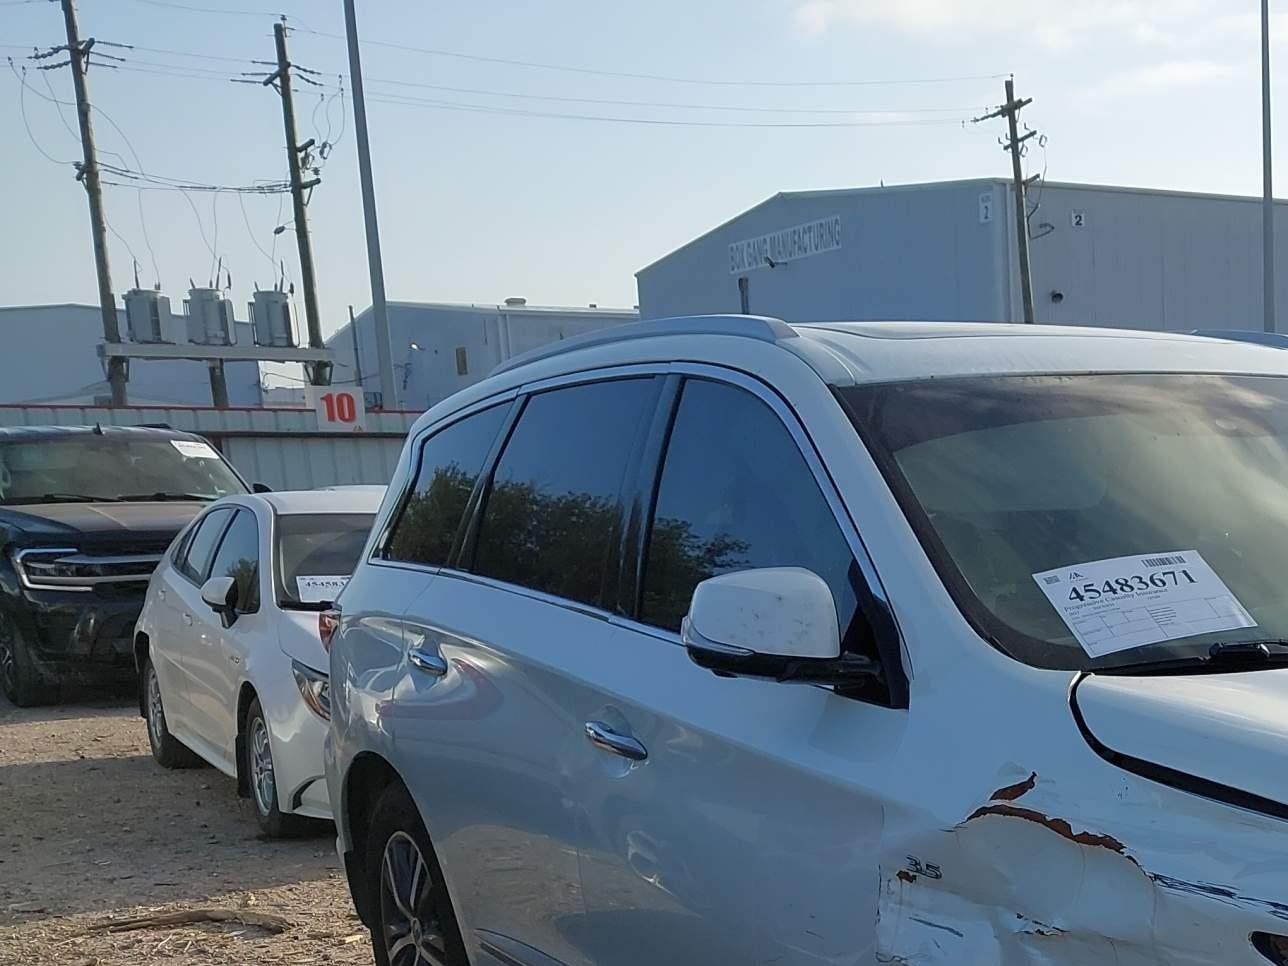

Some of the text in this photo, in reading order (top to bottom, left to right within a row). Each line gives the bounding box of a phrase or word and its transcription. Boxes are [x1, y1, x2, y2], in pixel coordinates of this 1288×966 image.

[1074, 214, 1084, 226] 2
[769, 218, 840, 261] MANUFACTURING
[320, 393, 356, 422] 10
[1068, 569, 1199, 601] 45483671
